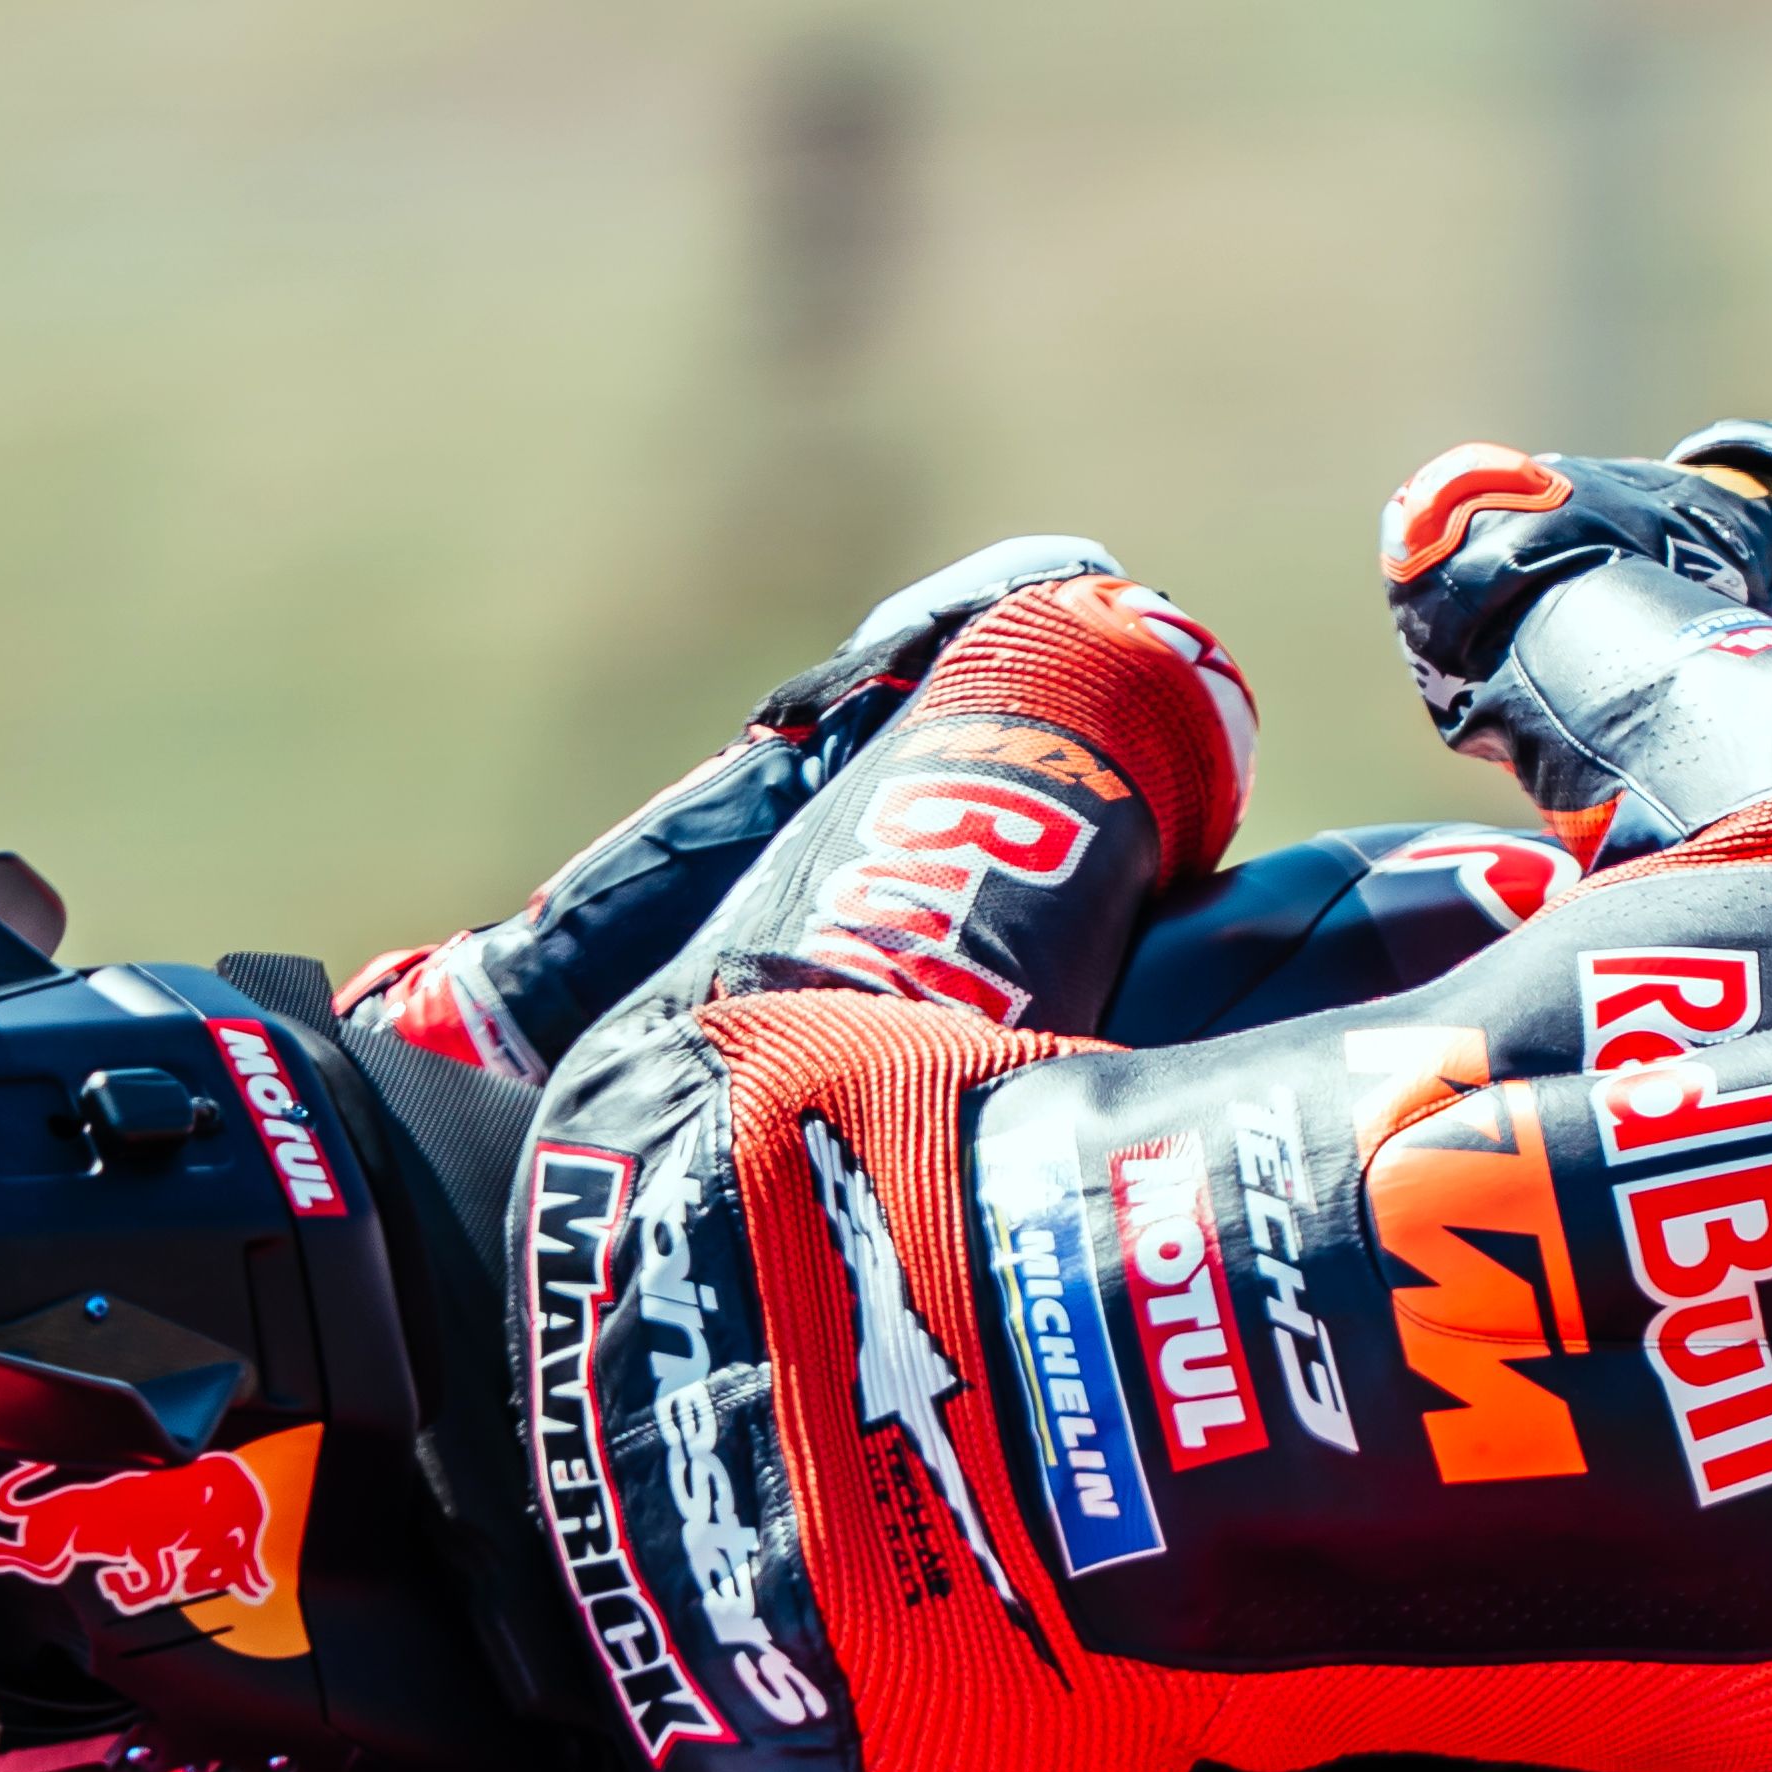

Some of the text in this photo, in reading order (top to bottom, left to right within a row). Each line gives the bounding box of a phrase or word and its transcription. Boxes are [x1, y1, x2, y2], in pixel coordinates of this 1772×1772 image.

[218, 1026, 335, 1209] MOTUL
[1344, 1026, 1590, 1484] KTM
[1015, 1228, 1120, 1519] MICHELIN
[1120, 1156, 1247, 1450] MOTUL
[534, 1157, 723, 1755] MAVERICK
